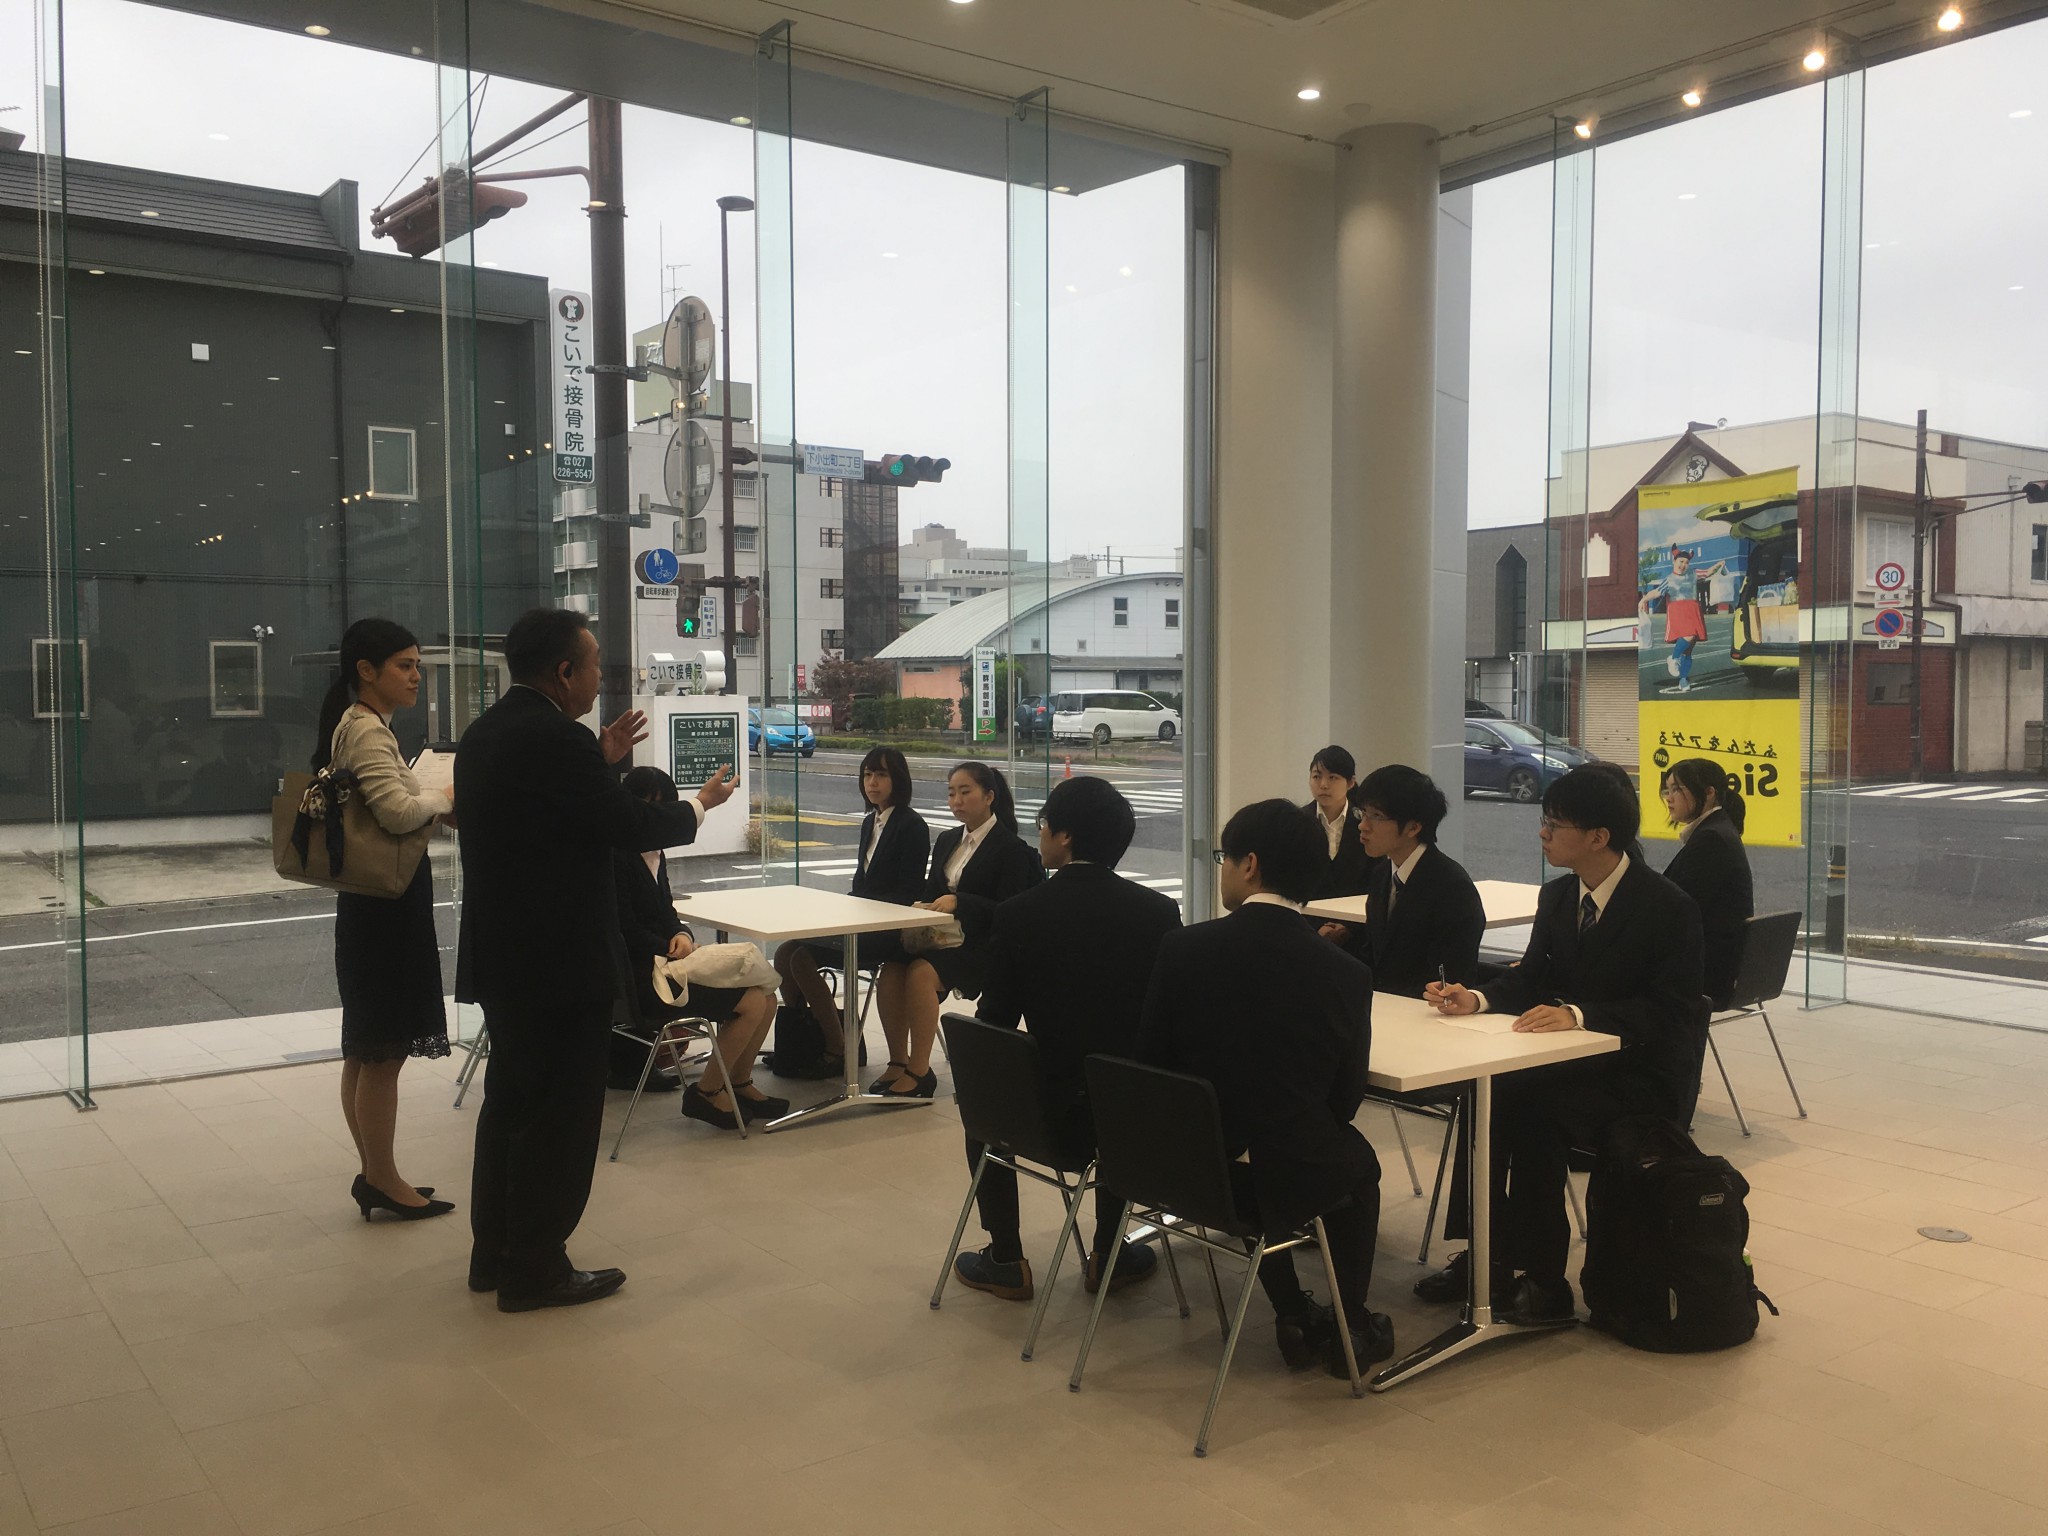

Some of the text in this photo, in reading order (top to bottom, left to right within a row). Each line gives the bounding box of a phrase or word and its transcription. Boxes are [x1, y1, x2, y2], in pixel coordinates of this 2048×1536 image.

[563, 324, 585, 452] こいで接骨院
[572, 456, 586, 467] 027
[807, 452, 861, 468] 下小出町二丁目
[557, 468, 593, 479] 226-5547
[1882, 570, 1899, 584] 30
[650, 663, 703, 680] こいで接骨院
[679, 720, 730, 729] こいで接骨院
[982, 719, 990, 728] P
